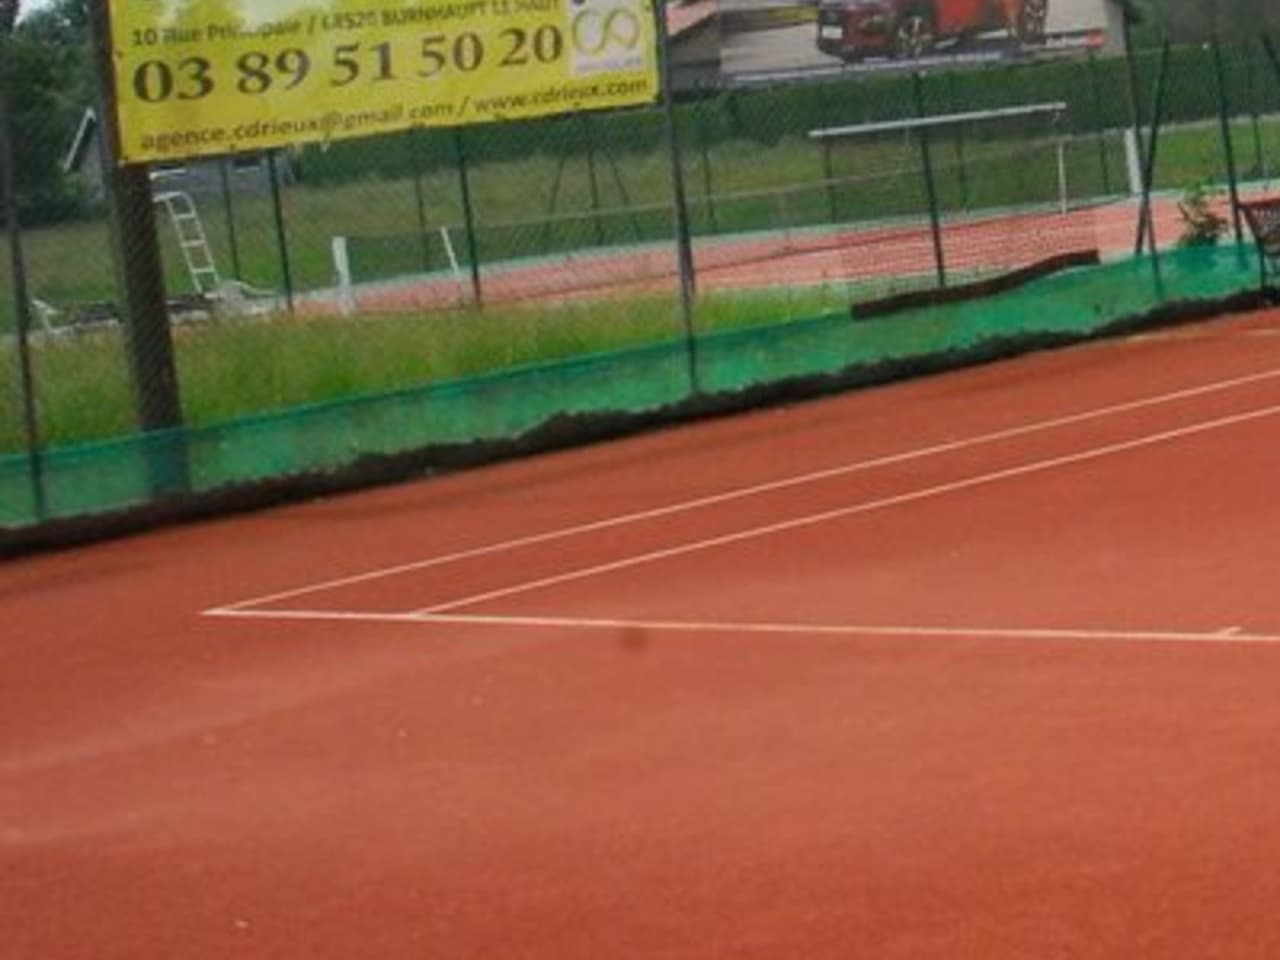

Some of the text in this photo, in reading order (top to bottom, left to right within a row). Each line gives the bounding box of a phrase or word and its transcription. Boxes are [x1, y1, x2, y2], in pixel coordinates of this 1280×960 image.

[132, 28, 158, 46] 10
[133, 23, 563, 103] 03 89 51 50 20
